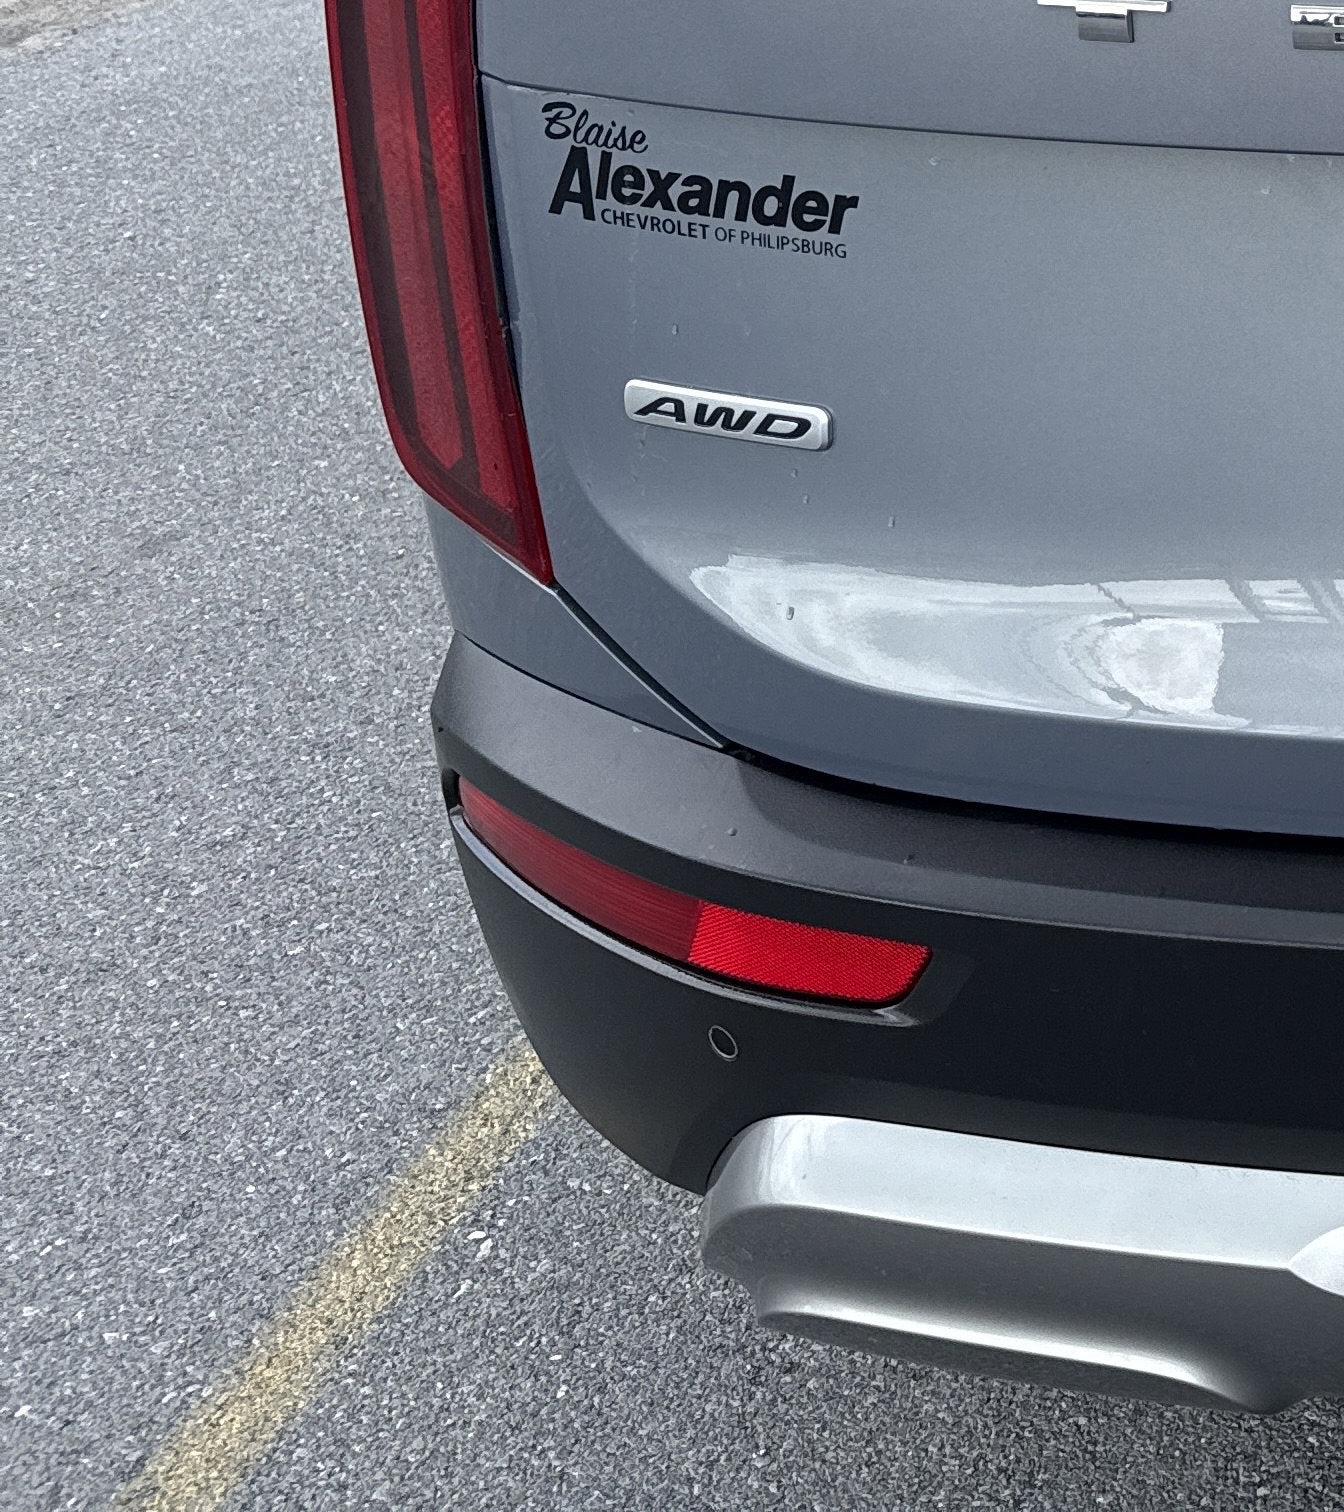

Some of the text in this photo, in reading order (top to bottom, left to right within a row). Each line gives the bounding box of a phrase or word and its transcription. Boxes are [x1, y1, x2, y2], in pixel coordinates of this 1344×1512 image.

[541, 101, 649, 154] Blaise
[548, 144, 860, 236] Alexander
[600, 207, 848, 259] CHEVROLET OF PHILIPSBURG
[633, 396, 813, 441] AWD
